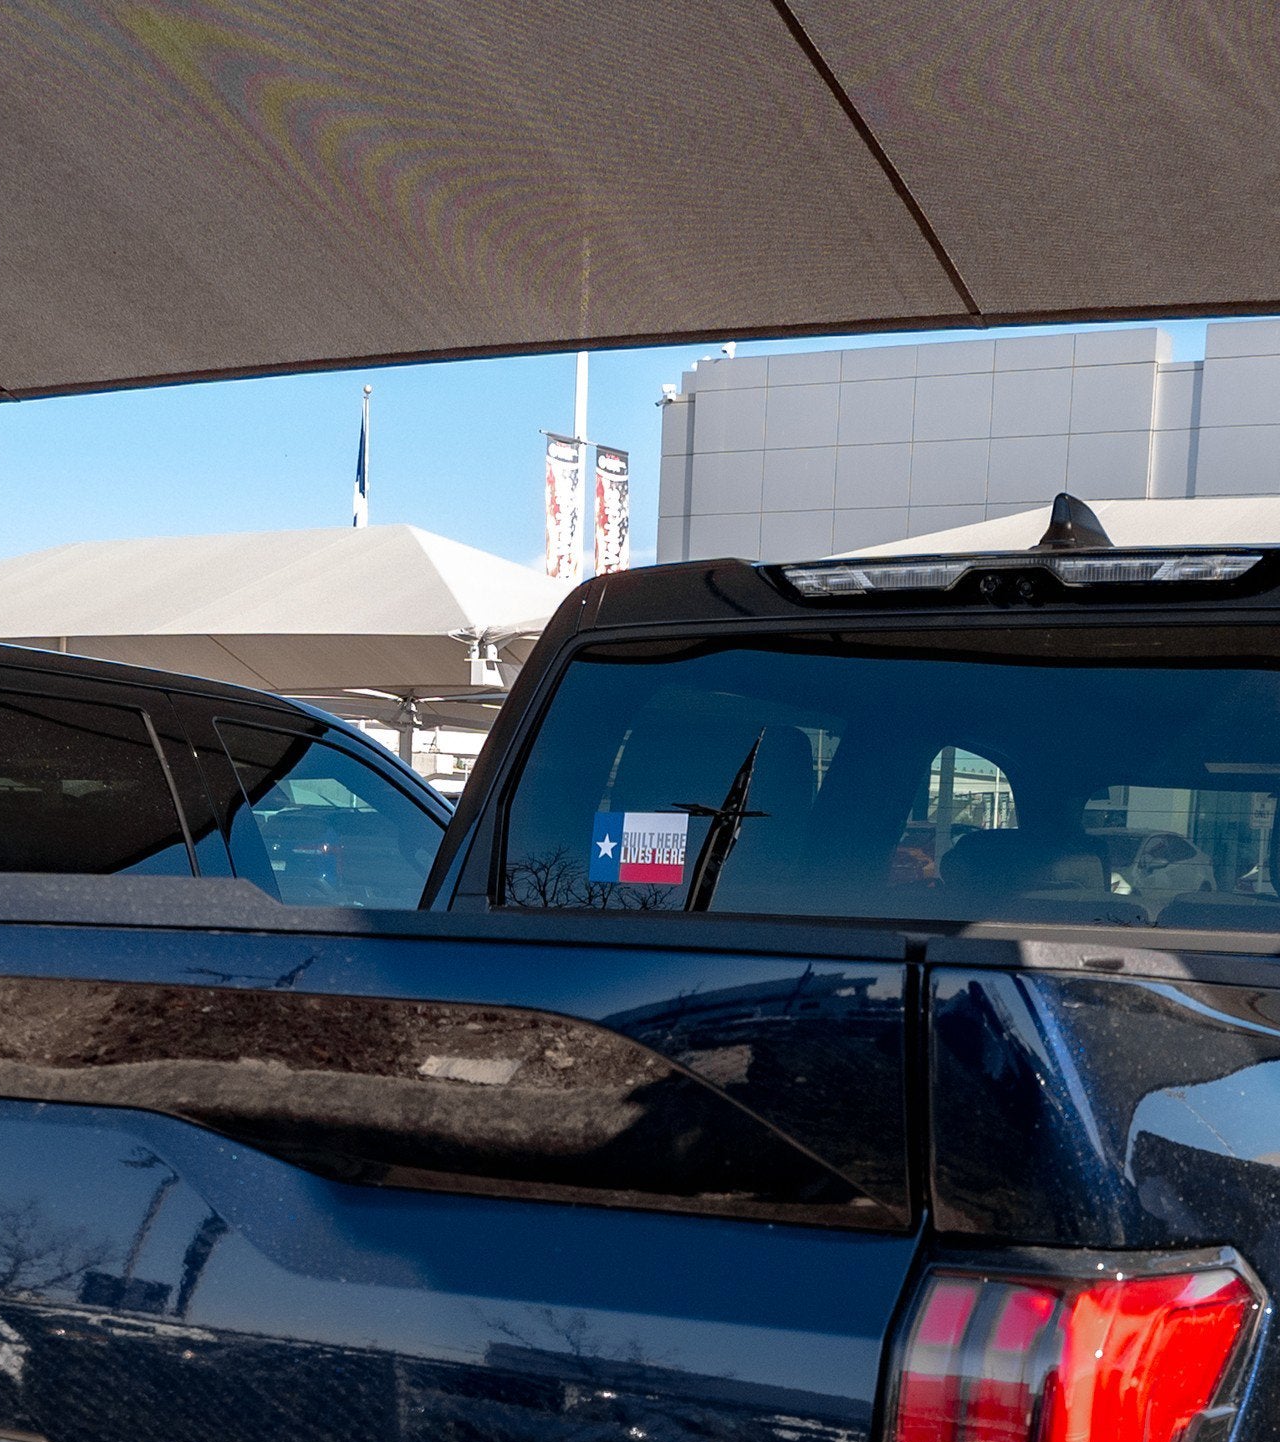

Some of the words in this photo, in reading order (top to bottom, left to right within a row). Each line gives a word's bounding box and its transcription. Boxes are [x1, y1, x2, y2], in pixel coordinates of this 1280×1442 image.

[622, 832, 655, 848] BUILT
[656, 832, 687, 848] HERE
[620, 847, 652, 864] LIVES
[654, 848, 685, 865] HERE
